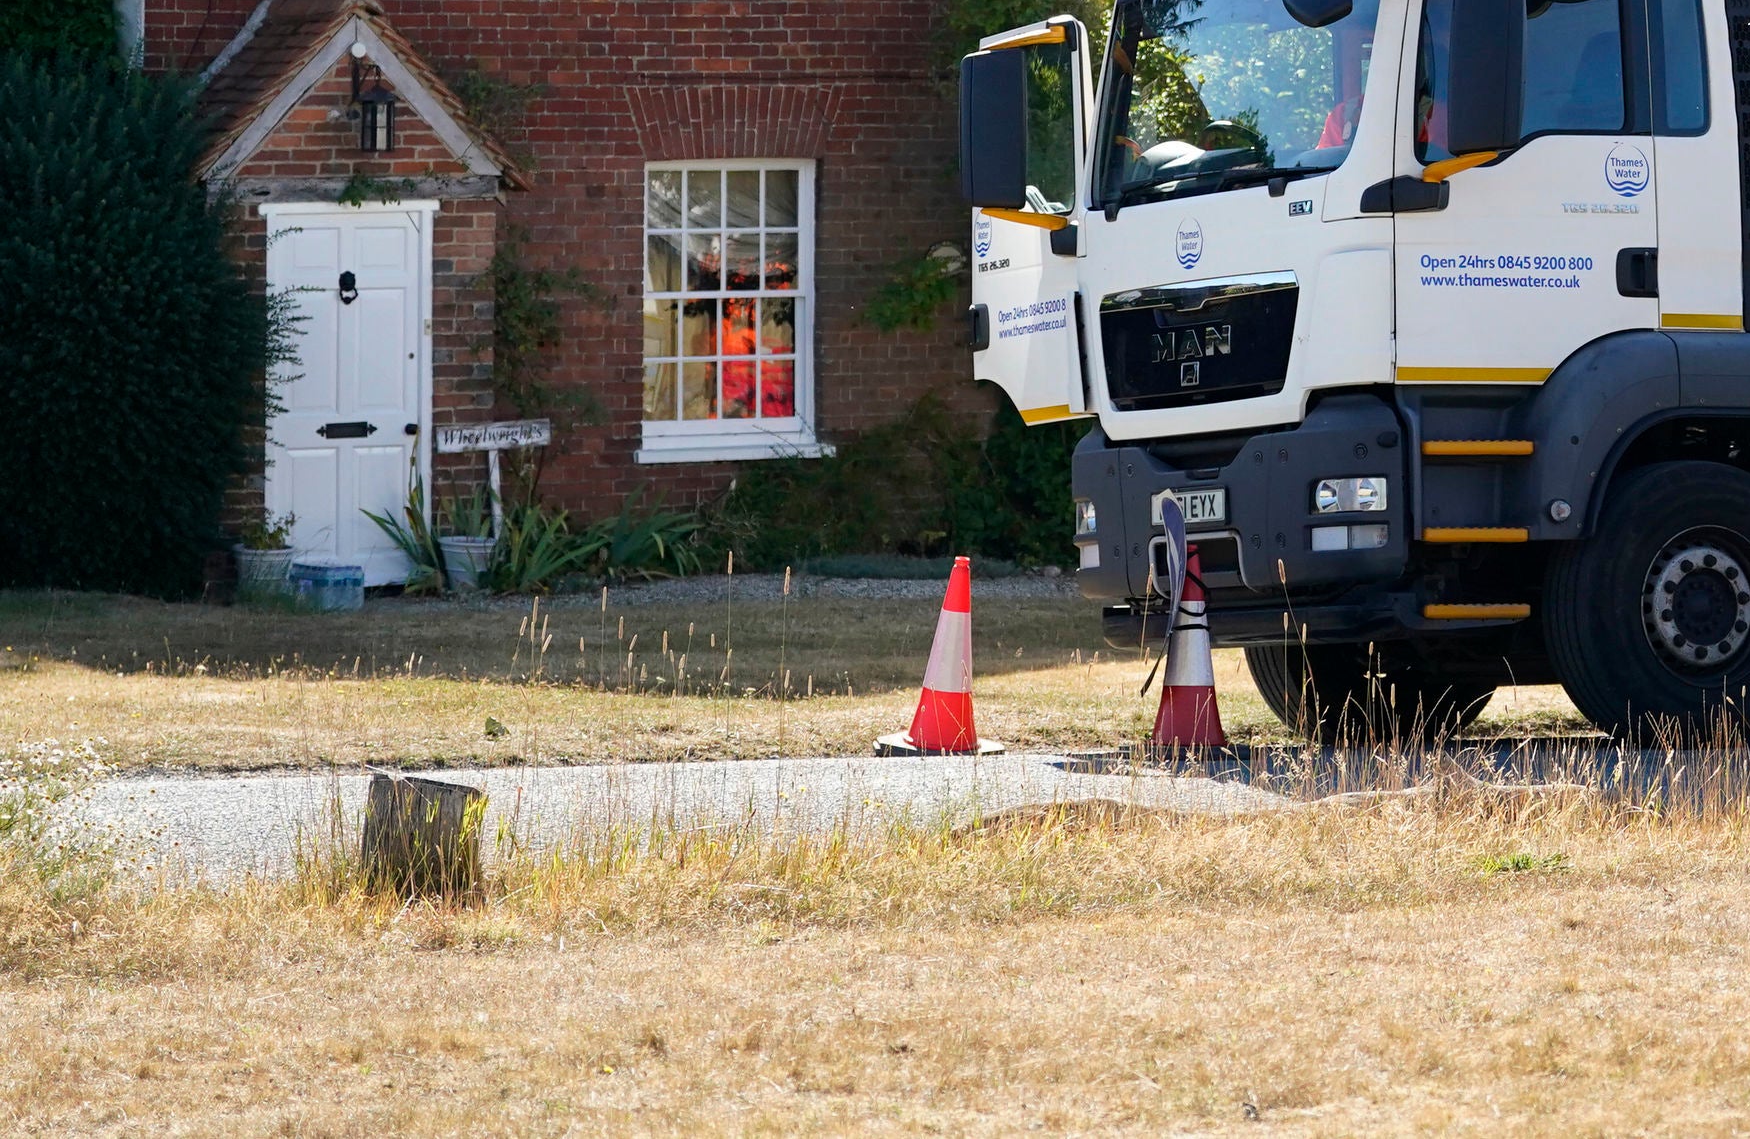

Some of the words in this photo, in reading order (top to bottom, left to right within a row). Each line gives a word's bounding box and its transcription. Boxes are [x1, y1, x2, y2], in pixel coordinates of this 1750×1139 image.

[1610, 157, 1644, 167] Thames
[1614, 169, 1641, 178] Water
[1290, 201, 1312, 214] EEV
[977, 221, 990, 230] Thames
[1179, 231, 1200, 240] Thames
[1182, 241, 1198, 251] Water
[1420, 254, 1456, 271] Open
[1458, 255, 1495, 269] 24hrs
[1497, 255, 1531, 269] 0845
[1534, 256, 1566, 270] 9200
[1568, 257, 1593, 271] 800
[1420, 273, 1580, 288] www.thameswater.co.uk
[998, 310, 1013, 325] Open
[1013, 306, 1029, 320] 24hrs
[1029, 302, 1044, 317] 0845
[1045, 299, 1061, 314] 9200
[1151, 324, 1231, 363] MAN
[1190, 493, 1216, 519] EYX
